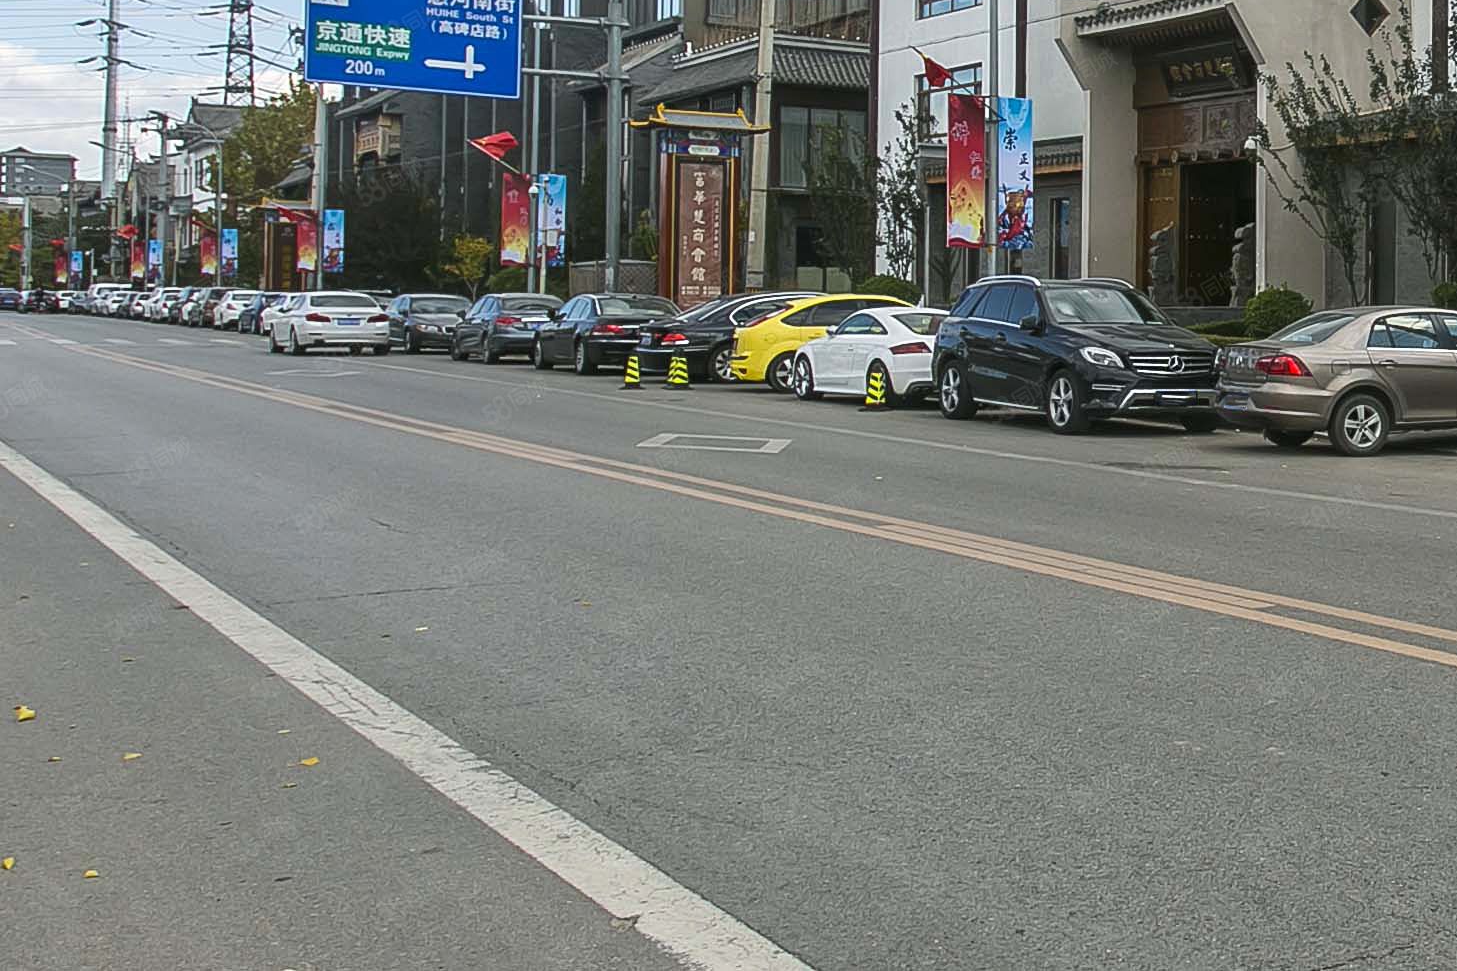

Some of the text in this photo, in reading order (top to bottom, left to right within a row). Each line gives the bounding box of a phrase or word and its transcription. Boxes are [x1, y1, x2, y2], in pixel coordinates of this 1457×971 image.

[426, 7, 514, 25] HUIHE South St
[316, 20, 411, 48] 京通快速
[315, 42, 410, 61] JINGTONG Expwy
[1003, 128, 1018, 151] 崇
